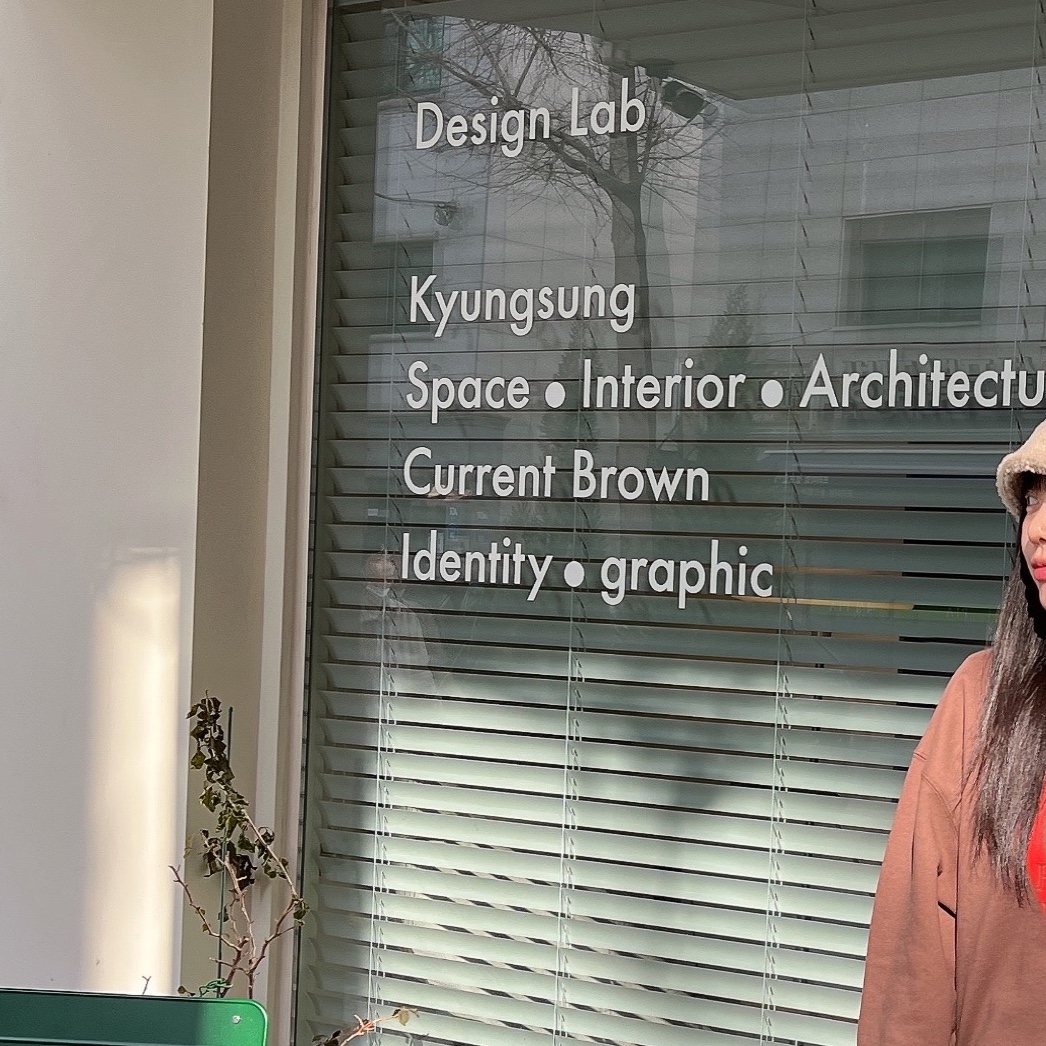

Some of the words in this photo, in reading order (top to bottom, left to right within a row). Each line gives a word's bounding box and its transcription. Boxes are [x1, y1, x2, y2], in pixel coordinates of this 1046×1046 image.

[416, 97, 552, 158] Design
[570, 77, 646, 137] Lab
[410, 274, 637, 338] Kyungsung
[405, 360, 530, 424] Space
[582, 356, 748, 409] Interior
[403, 446, 557, 499] Current
[573, 449, 709, 503] Brown
[401, 529, 555, 601] Identity
[600, 538, 774, 610] graphic
